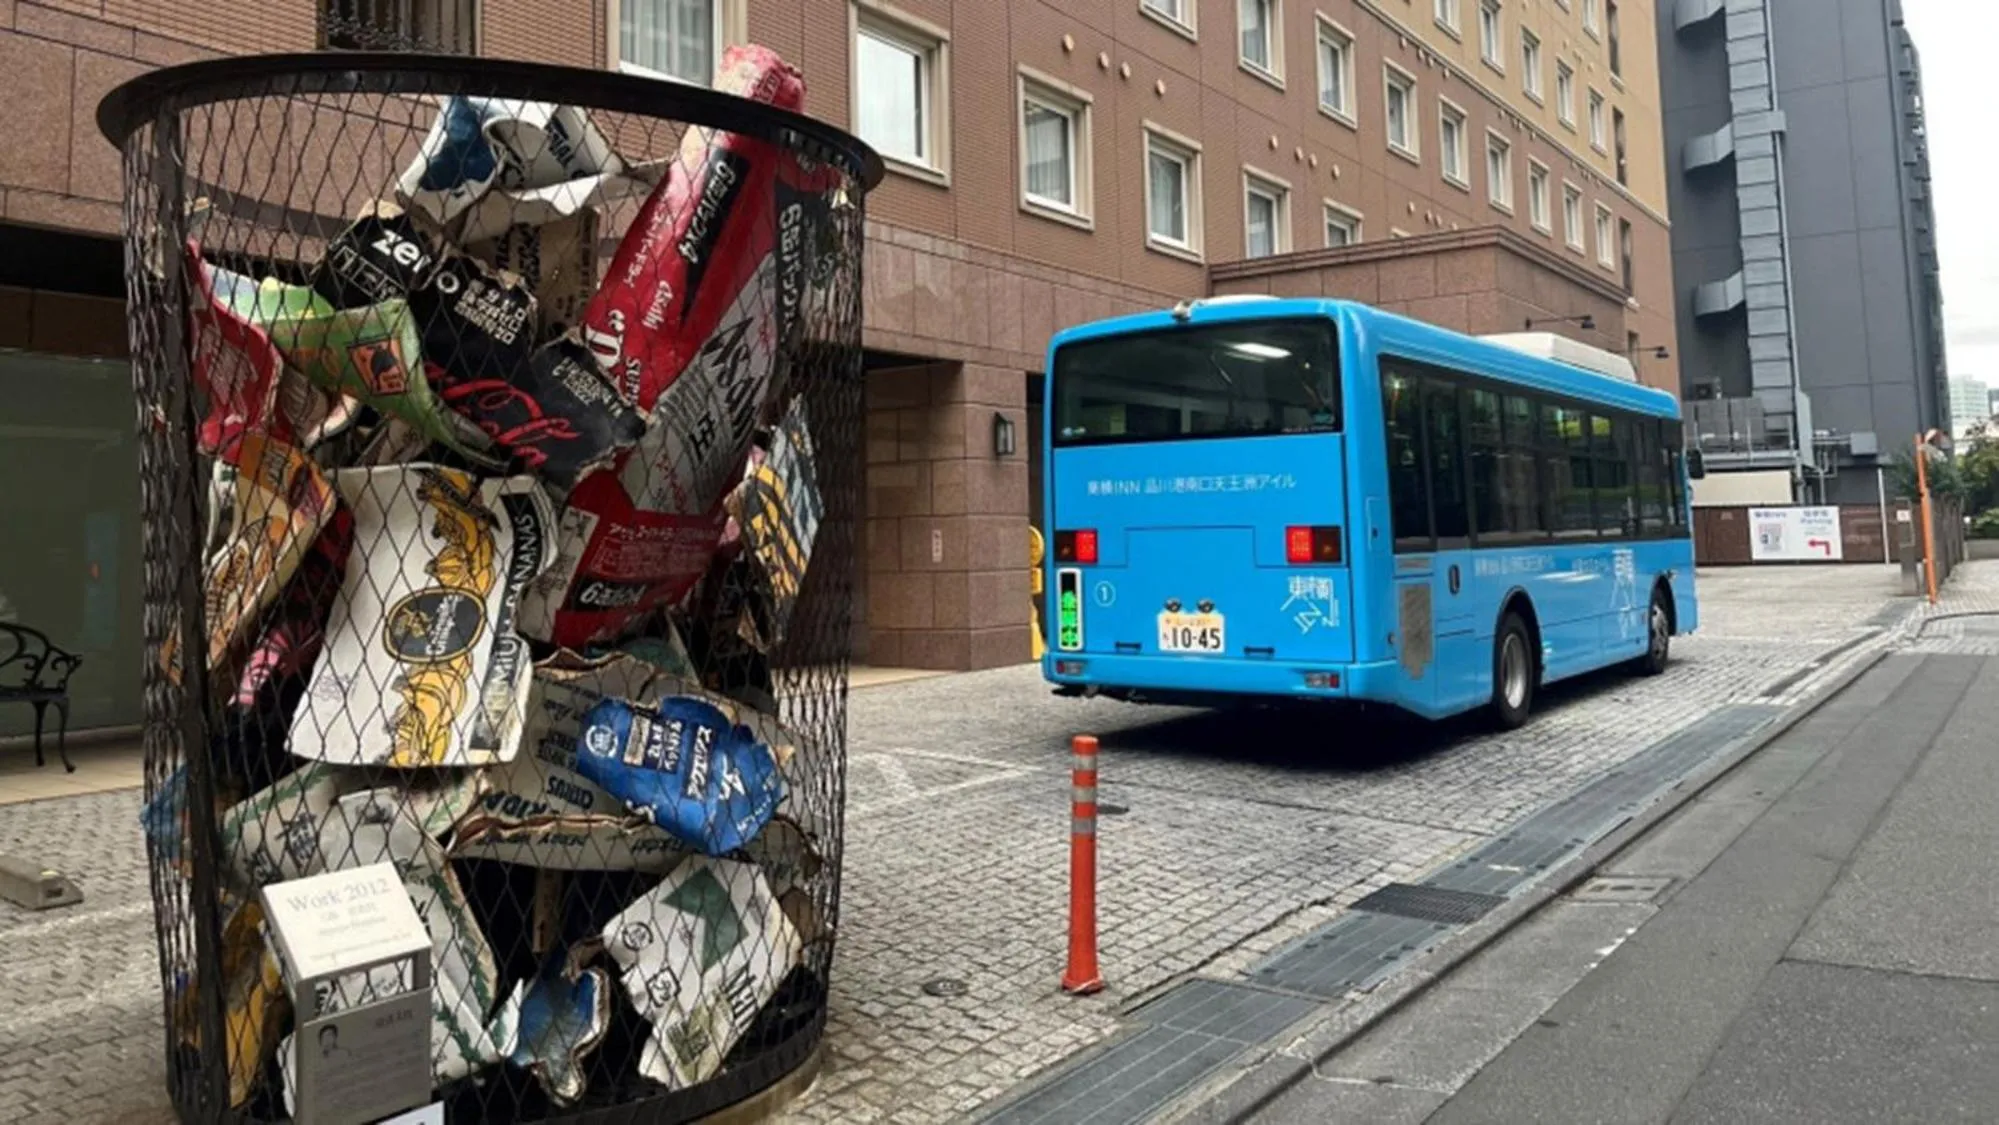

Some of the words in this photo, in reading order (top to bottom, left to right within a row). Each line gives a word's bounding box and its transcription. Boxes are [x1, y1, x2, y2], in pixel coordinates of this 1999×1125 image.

[1171, 626, 1220, 649] 10-45
[287, 890, 342, 913] Work
[344, 878, 392, 901] 2012
